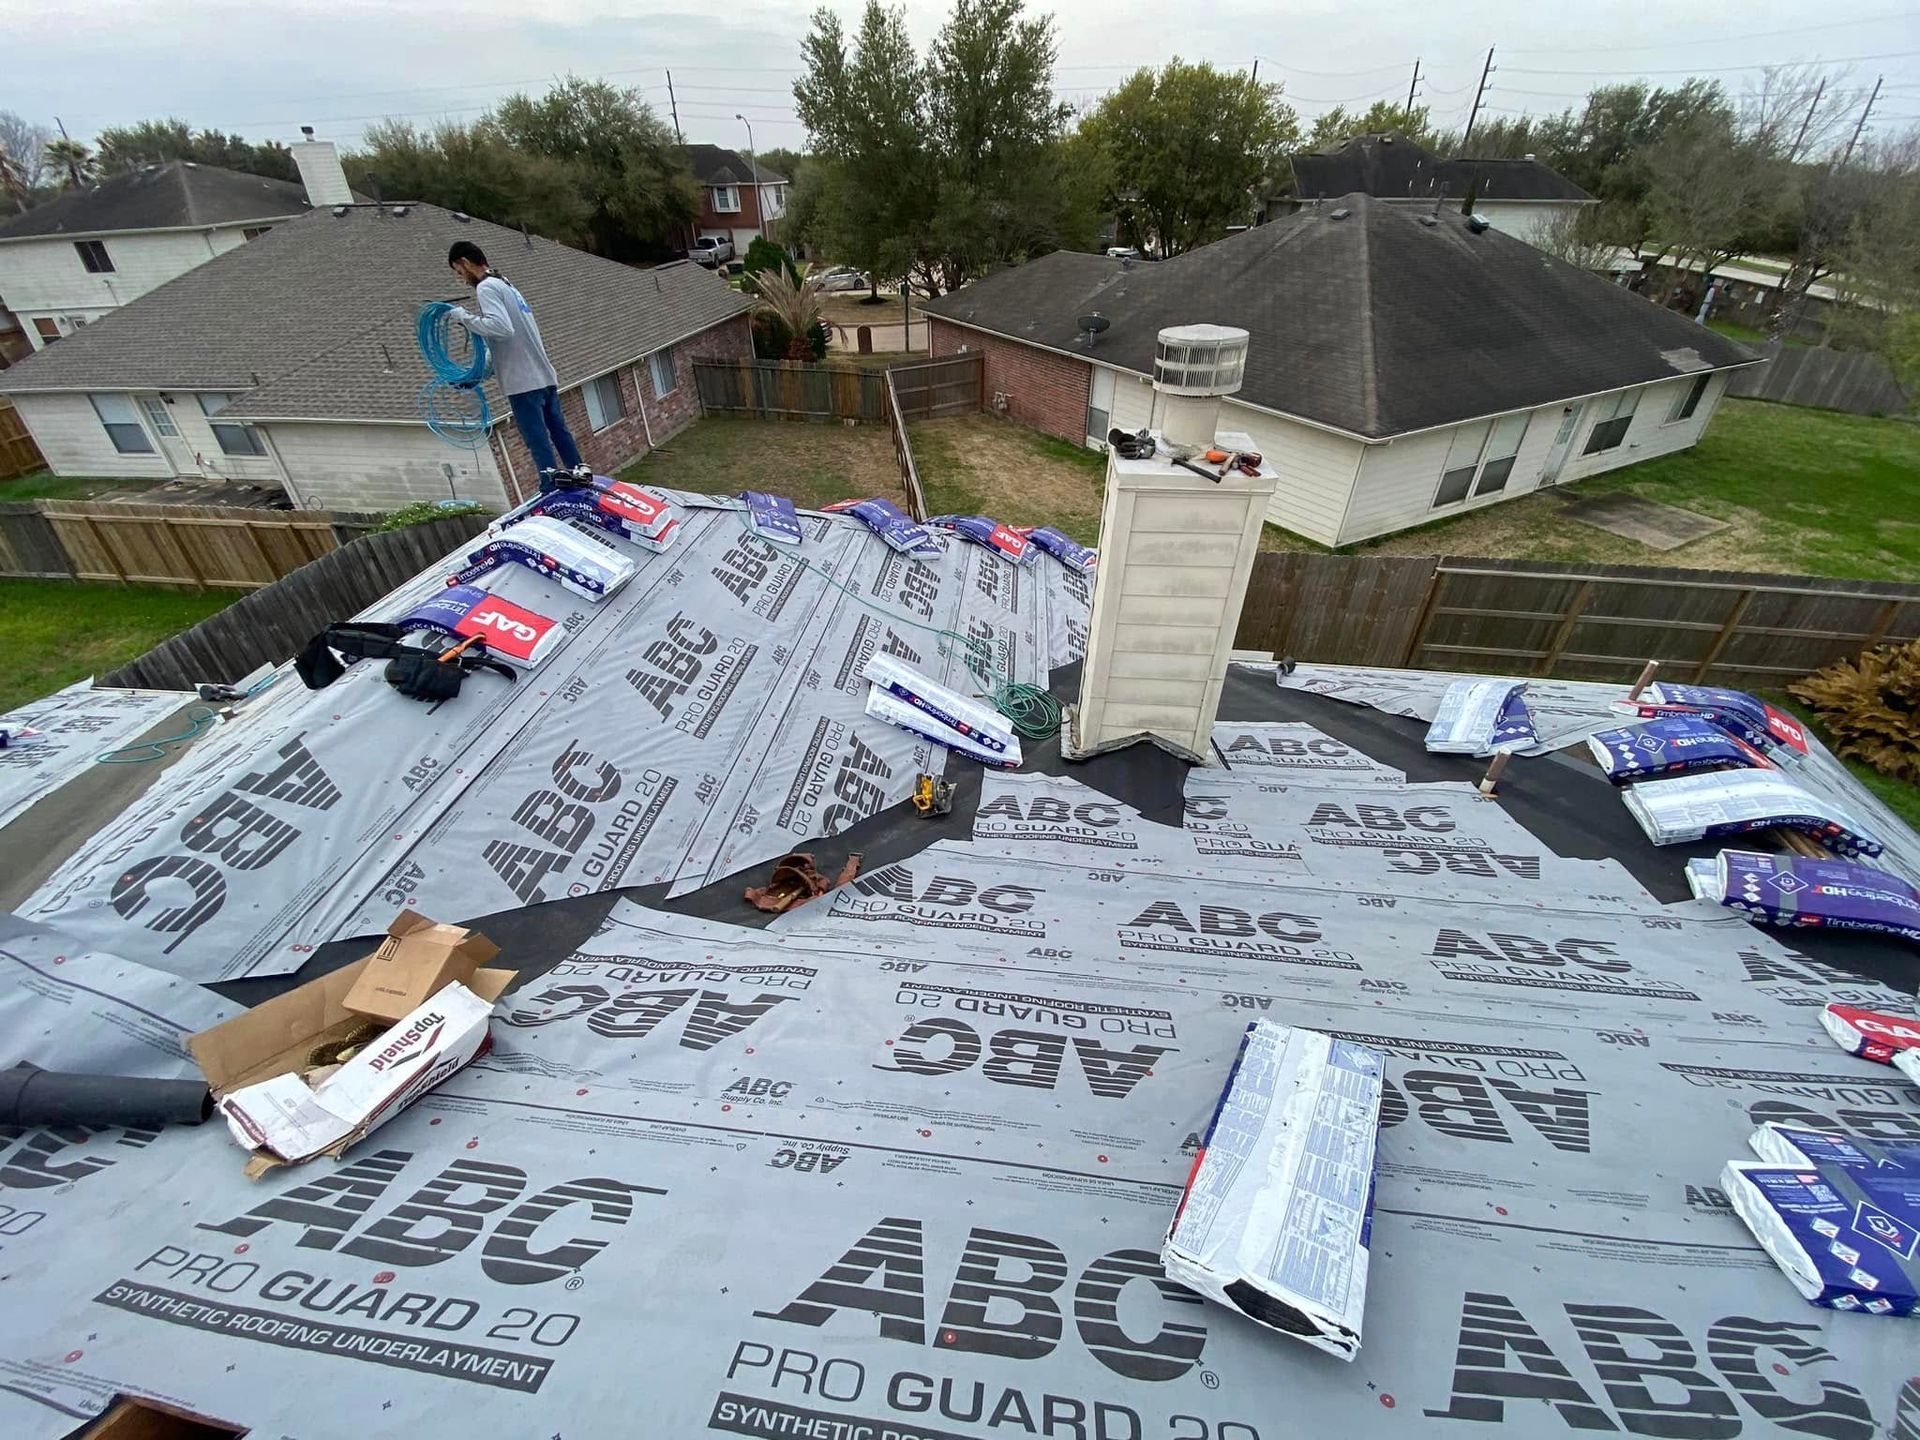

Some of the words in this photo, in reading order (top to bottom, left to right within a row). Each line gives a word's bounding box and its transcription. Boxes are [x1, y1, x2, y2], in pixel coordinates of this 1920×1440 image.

[605, 489, 656, 516] GAF
[996, 531, 1023, 549] GAF
[752, 595, 771, 619] PRO
[766, 565, 790, 600] GUARD
[471, 611, 538, 642] GAF
[561, 611, 586, 634] ABC
[867, 618, 883, 640] PRO
[624, 610, 718, 724] ABC
[771, 644, 788, 666] ABC
[851, 639, 876, 679] GUARD
[562, 675, 590, 703] ABC
[675, 701, 706, 735] PRO
[698, 654, 736, 701] GUARD
[727, 637, 747, 655] 20
[845, 677, 861, 697] 20
[825, 720, 846, 752] PRO
[1770, 717, 1802, 742] GAF
[912, 745, 925, 768] ABC
[1228, 734, 1349, 757] ABC
[401, 754, 439, 792] ABC
[802, 752, 835, 809] GUARD
[694, 772, 719, 805] ABC
[481, 738, 622, 906] ABC
[581, 799, 642, 878] GUARD
[635, 768, 662, 797] 20
[739, 806, 761, 836] ABC
[792, 808, 813, 837] 20
[976, 795, 1125, 828] ABC
[1301, 802, 1456, 833] ABC
[111, 731, 343, 955] ABC
[974, 822, 1006, 832] RO
[1014, 824, 1097, 837] GUARD
[1106, 830, 1136, 841] 20
[1194, 836, 1243, 849] PRO
[1360, 830, 1447, 844] GUARD
[1455, 837, 1488, 847] 20
[610, 849, 635, 883] ROOFING
[1088, 872, 1126, 883] ABC
[384, 860, 427, 909] ABC
[850, 864, 1046, 914] ABC
[833, 890, 888, 913] PRO
[897, 904, 998, 925] GUARD
[1008, 918, 1046, 930] 20
[1357, 897, 1397, 908] ABC
[1117, 901, 1322, 943] ABC
[1641, 919, 1684, 930] ABC
[1027, 947, 1073, 959] ABC
[1117, 930, 1179, 945] PRO
[1189, 936, 1303, 956] GUARD
[1311, 949, 1355, 961] 20
[1421, 928, 1632, 973] ABC
[550, 964, 600, 976] 20
[606, 968, 731, 983] GUARD
[879, 961, 928, 973] ABC
[1430, 960, 1499, 974] PRO
[1507, 966, 1629, 986] GUARD
[741, 975, 813, 990] PRO
[902, 982, 1018, 1001] UNDERLAYMENT
[1359, 978, 1408, 990] ABC
[895, 990, 942, 1008] 20
[1021, 996, 1086, 1010] ROOFING
[1087, 1003, 1170, 1018] SYNTHETIC
[1222, 994, 1274, 1010] ABC
[955, 998, 1087, 1030] GUARD
[1712, 1012, 1763, 1023] ABC
[1100, 1018, 1177, 1039] PRO
[1596, 1032, 1651, 1048] ABC
[369, 1012, 445, 1073] TopShield
[872, 1017, 1180, 1099] ABC
[1495, 1060, 1587, 1082] PRO
[720, 1092, 752, 1103] Supply
[752, 1096, 767, 1105] Co.
[721, 1076, 797, 1098] ABC
[765, 1149, 852, 1174] ABC
[816, 1142, 850, 1155] Supply
[1685, 1184, 1732, 1208] AB
[195, 1151, 668, 1286] ABC
[134, 1245, 260, 1293] PRO
[258, 1269, 479, 1332] GUARD
[486, 1307, 582, 1348] 20
[752, 1217, 1209, 1382] ABC
[105, 1285, 228, 1326] SYNTHETIC
[225, 1312, 332, 1349] ROOFING
[332, 1331, 547, 1386] UNDERLAYMENT
[726, 1341, 865, 1403] PRO
[1423, 1292, 1882, 1440] ABC
